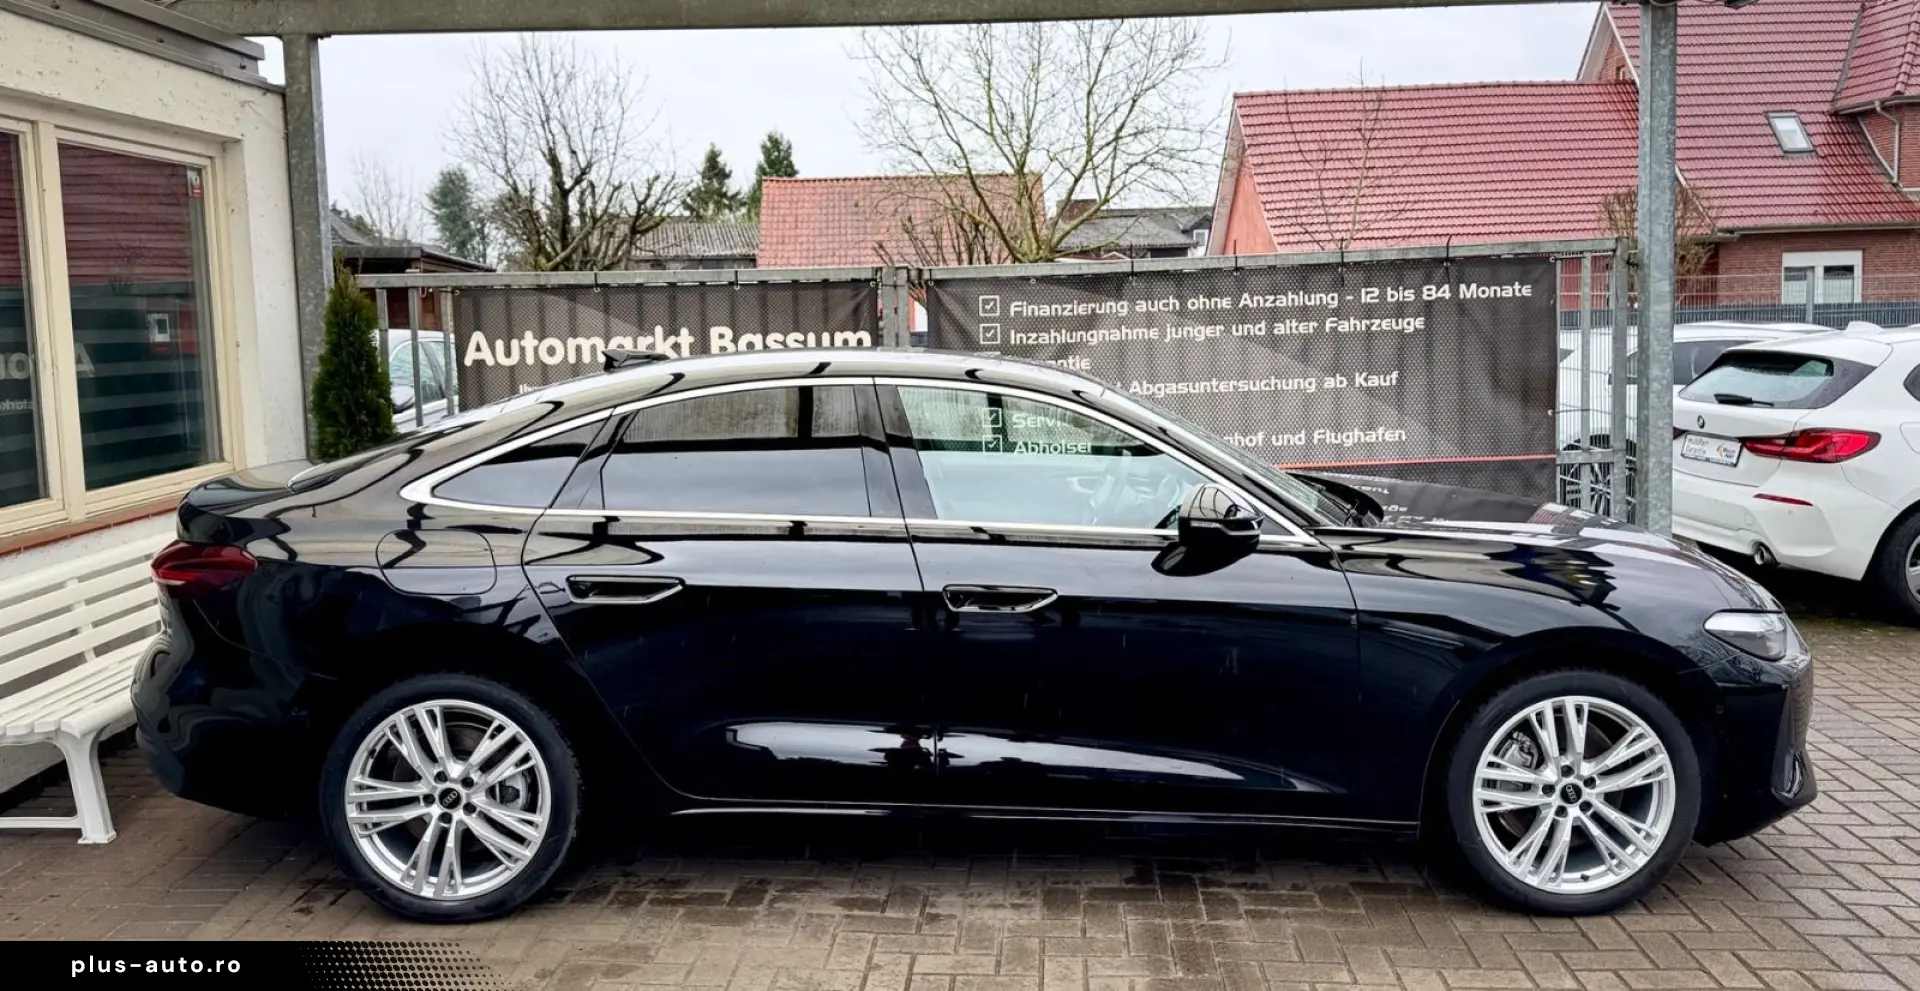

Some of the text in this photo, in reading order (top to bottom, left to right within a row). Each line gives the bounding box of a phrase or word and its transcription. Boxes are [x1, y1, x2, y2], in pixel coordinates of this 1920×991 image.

[1010, 299, 1129, 317] Finanzierung
[1135, 294, 1180, 312] auch
[1187, 294, 1232, 310] ohne
[1238, 290, 1339, 308] Anzahlung
[1361, 287, 1380, 303] 12
[1386, 286, 1415, 301] bis
[1422, 284, 1451, 301] 84
[1459, 282, 1532, 299] Monate
[709, 325, 872, 354] Bassum
[1010, 316, 1425, 346] Inzahlungnahme junger und alter Fahrzeuge
[1129, 376, 1316, 398] Abgasuntersuchung
[1324, 373, 1347, 388] ab
[1355, 371, 1400, 387] Kauf
[1272, 430, 1305, 446] und
[1313, 427, 1406, 447] Flughafen
